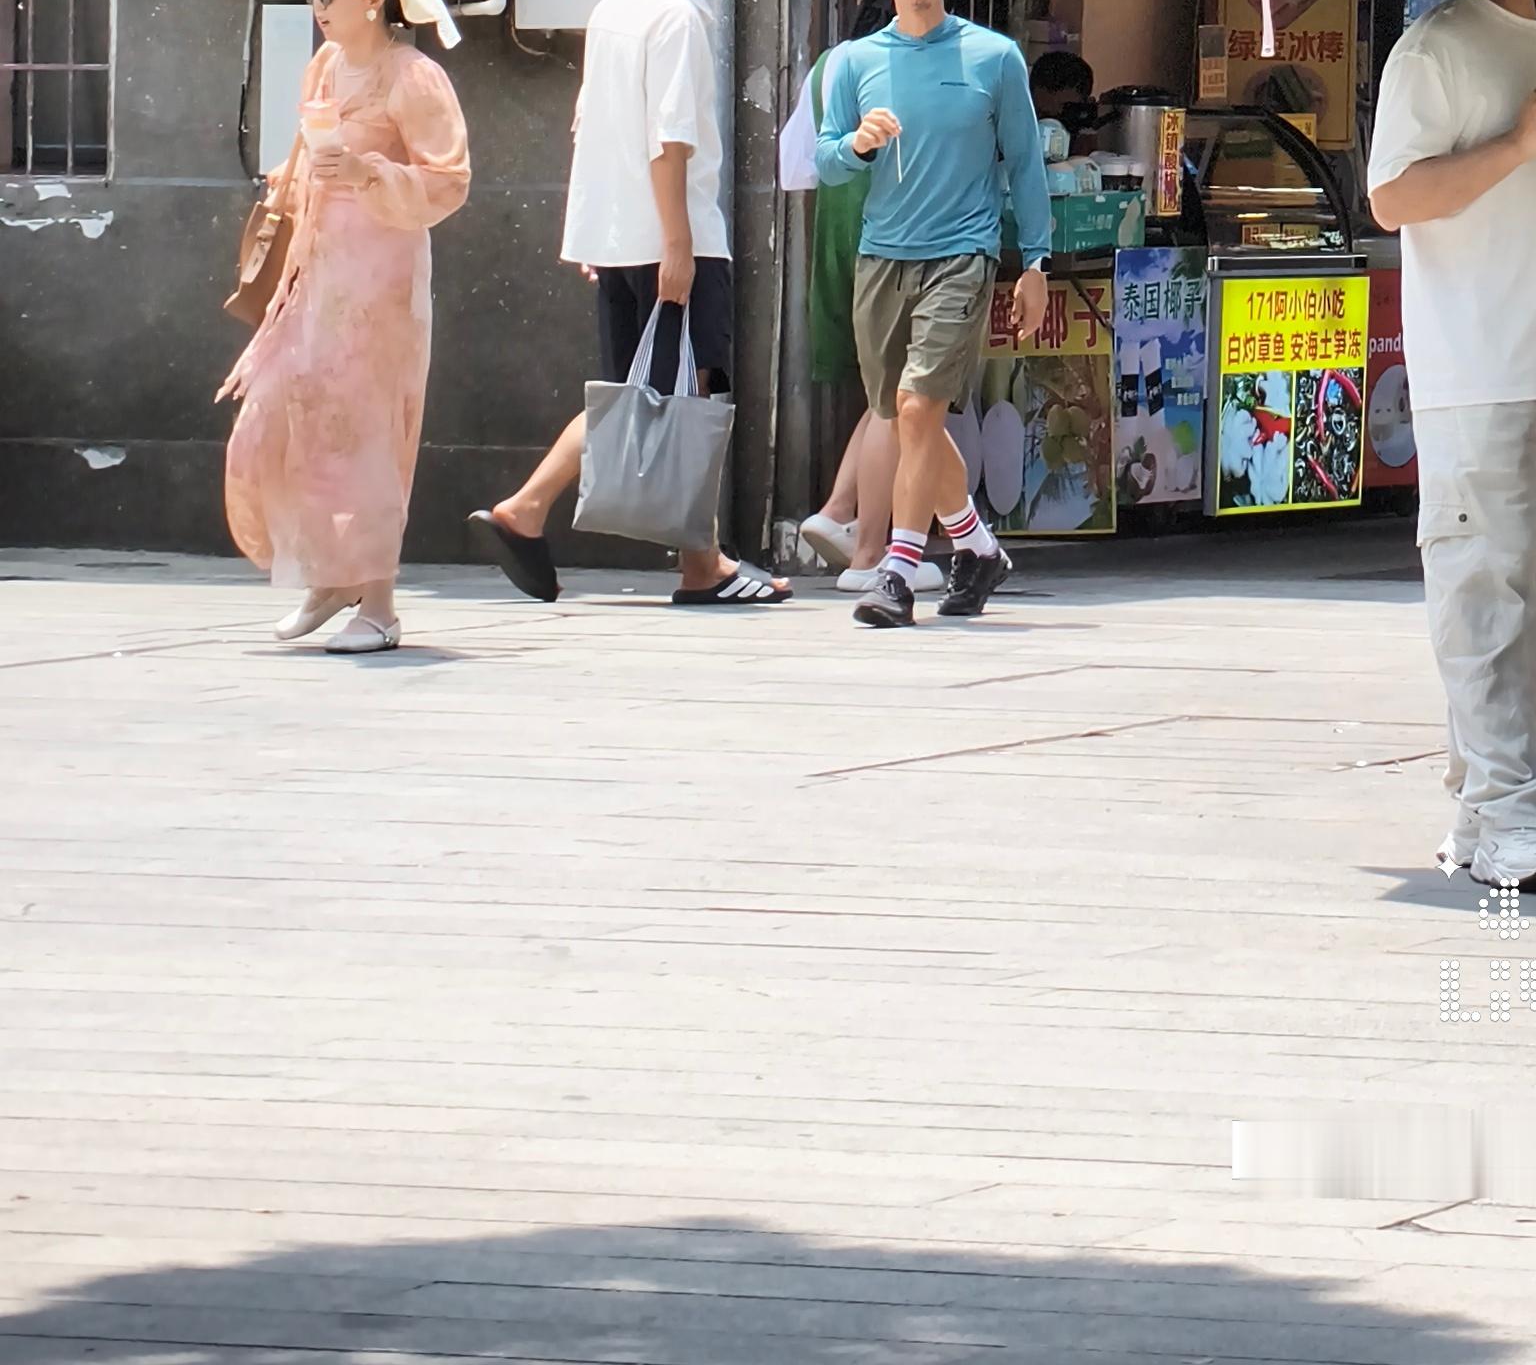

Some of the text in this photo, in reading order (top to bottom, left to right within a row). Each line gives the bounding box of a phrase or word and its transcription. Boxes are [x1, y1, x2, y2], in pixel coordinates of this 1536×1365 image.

[1122, 278, 1202, 320] 泰国椰子
[1247, 288, 1346, 321] 171阿小伯小吃
[1227, 328, 1362, 365] 白灼章鱼 安海土笋冻
[1368, 332, 1403, 359] pand
